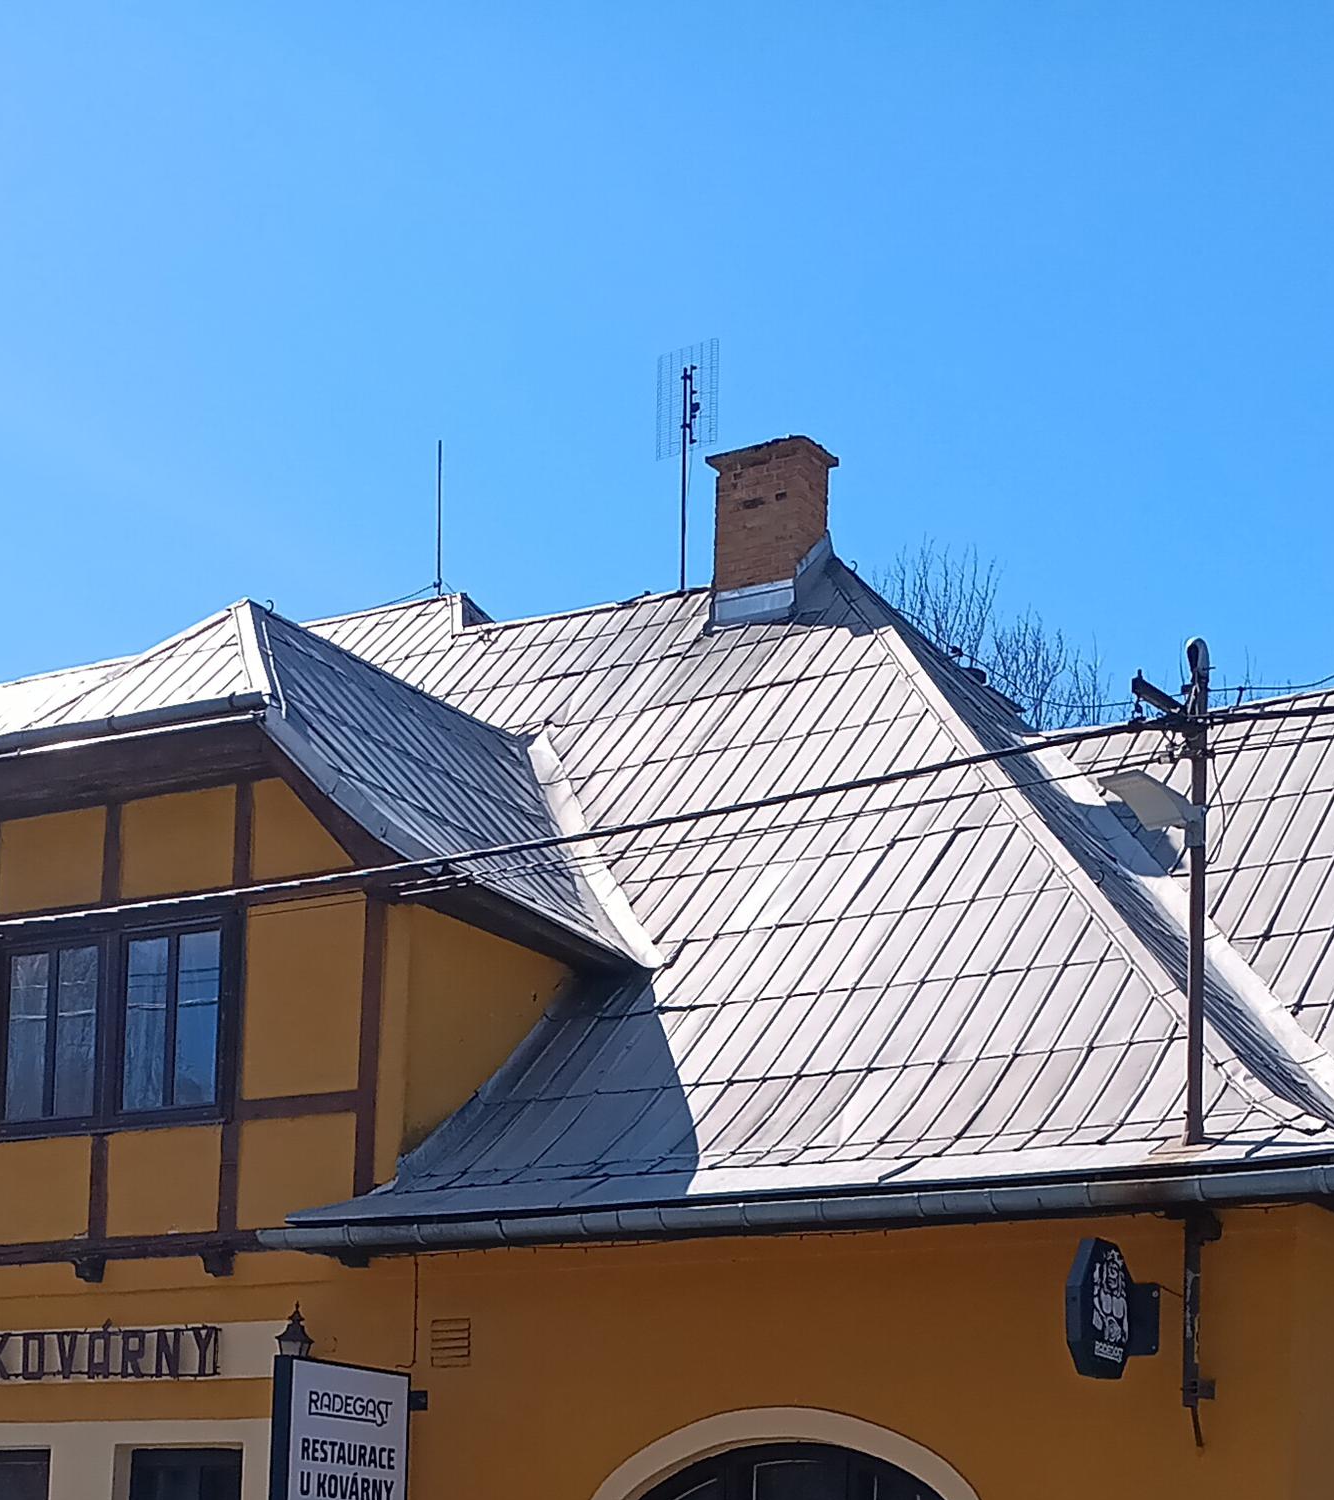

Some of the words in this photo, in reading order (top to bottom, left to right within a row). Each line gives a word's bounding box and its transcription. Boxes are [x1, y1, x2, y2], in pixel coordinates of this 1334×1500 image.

[308, 1390, 393, 1427] RADEGAST
[300, 1437, 395, 1470] RESTAURACE
[299, 1470, 311, 1496] U
